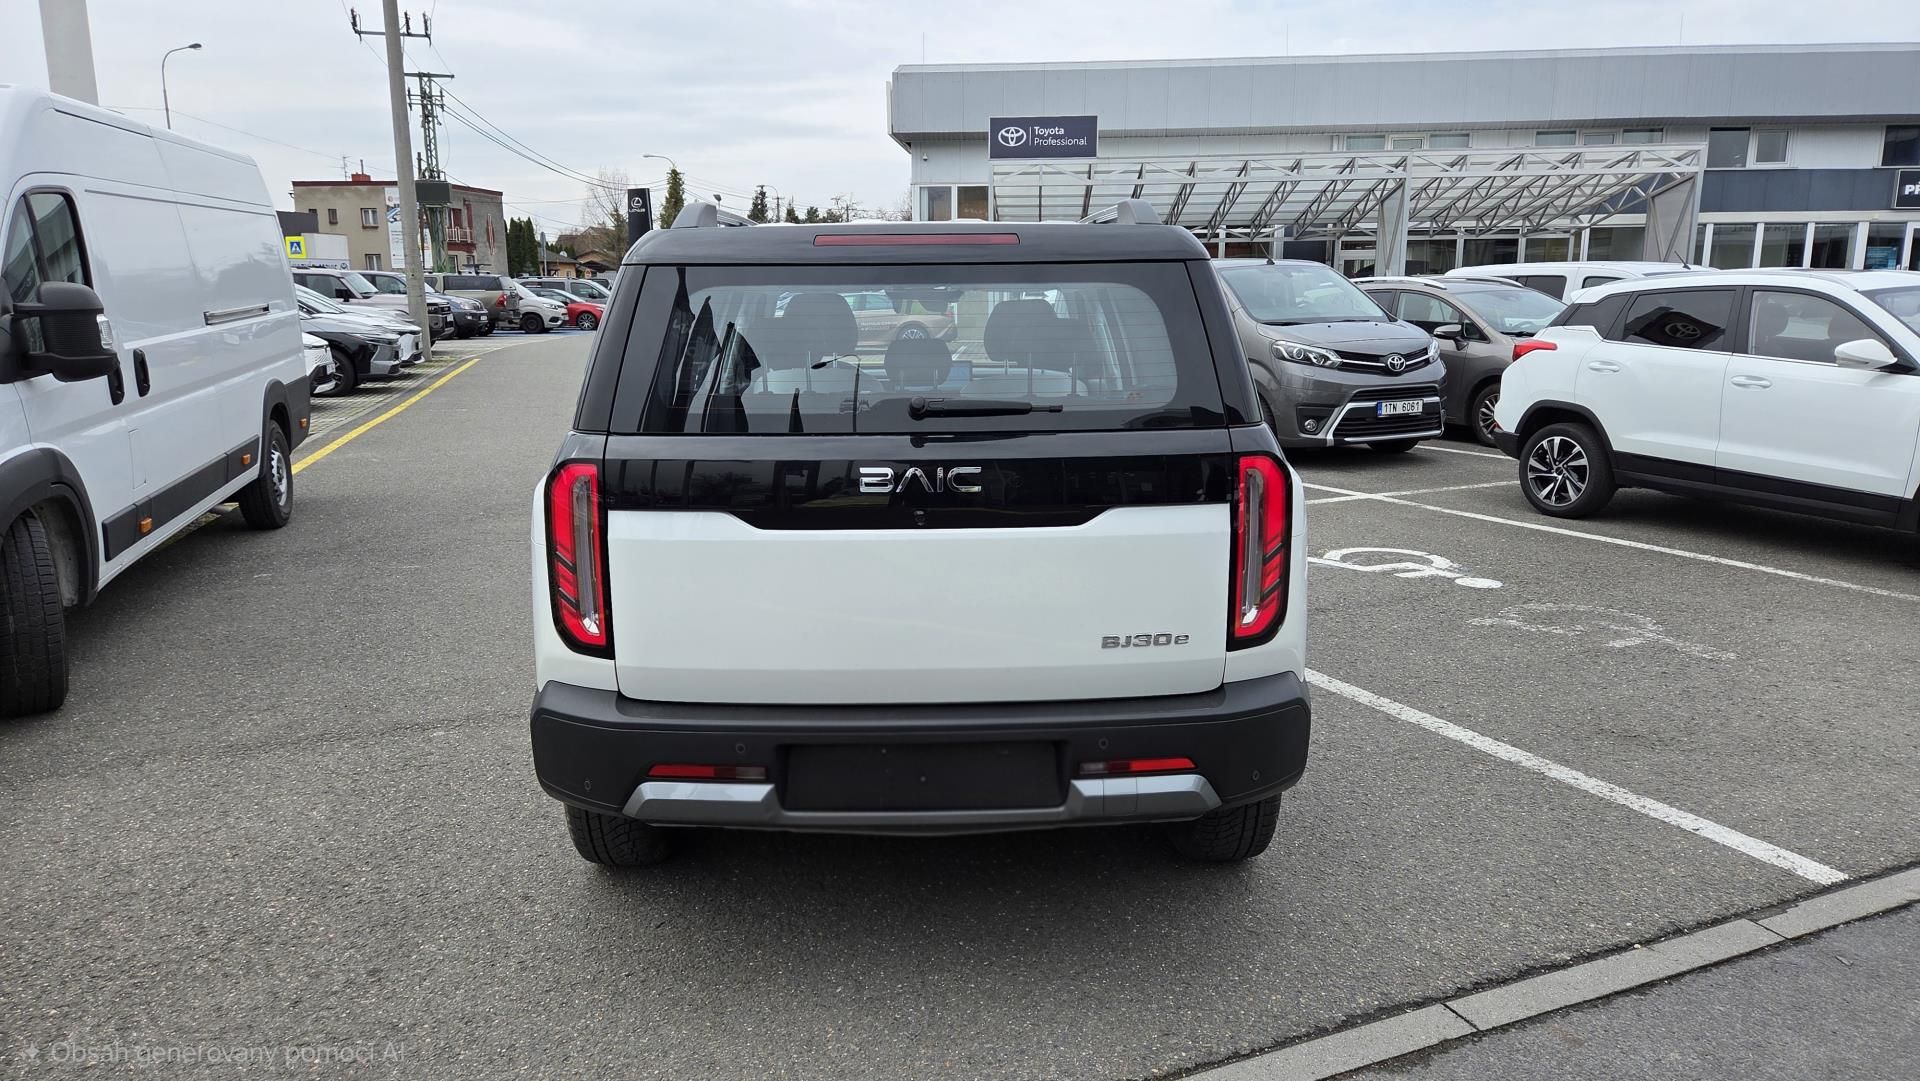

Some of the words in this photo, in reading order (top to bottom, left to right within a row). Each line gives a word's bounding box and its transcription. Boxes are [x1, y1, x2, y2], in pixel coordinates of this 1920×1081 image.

[1034, 126, 1064, 136] Toyota
[1034, 136, 1088, 146] Professional
[1384, 403, 1398, 413] 1TN
[1402, 401, 1419, 411] 6061
[859, 466, 982, 493] BAIC
[1101, 633, 1190, 649] BJ30e
